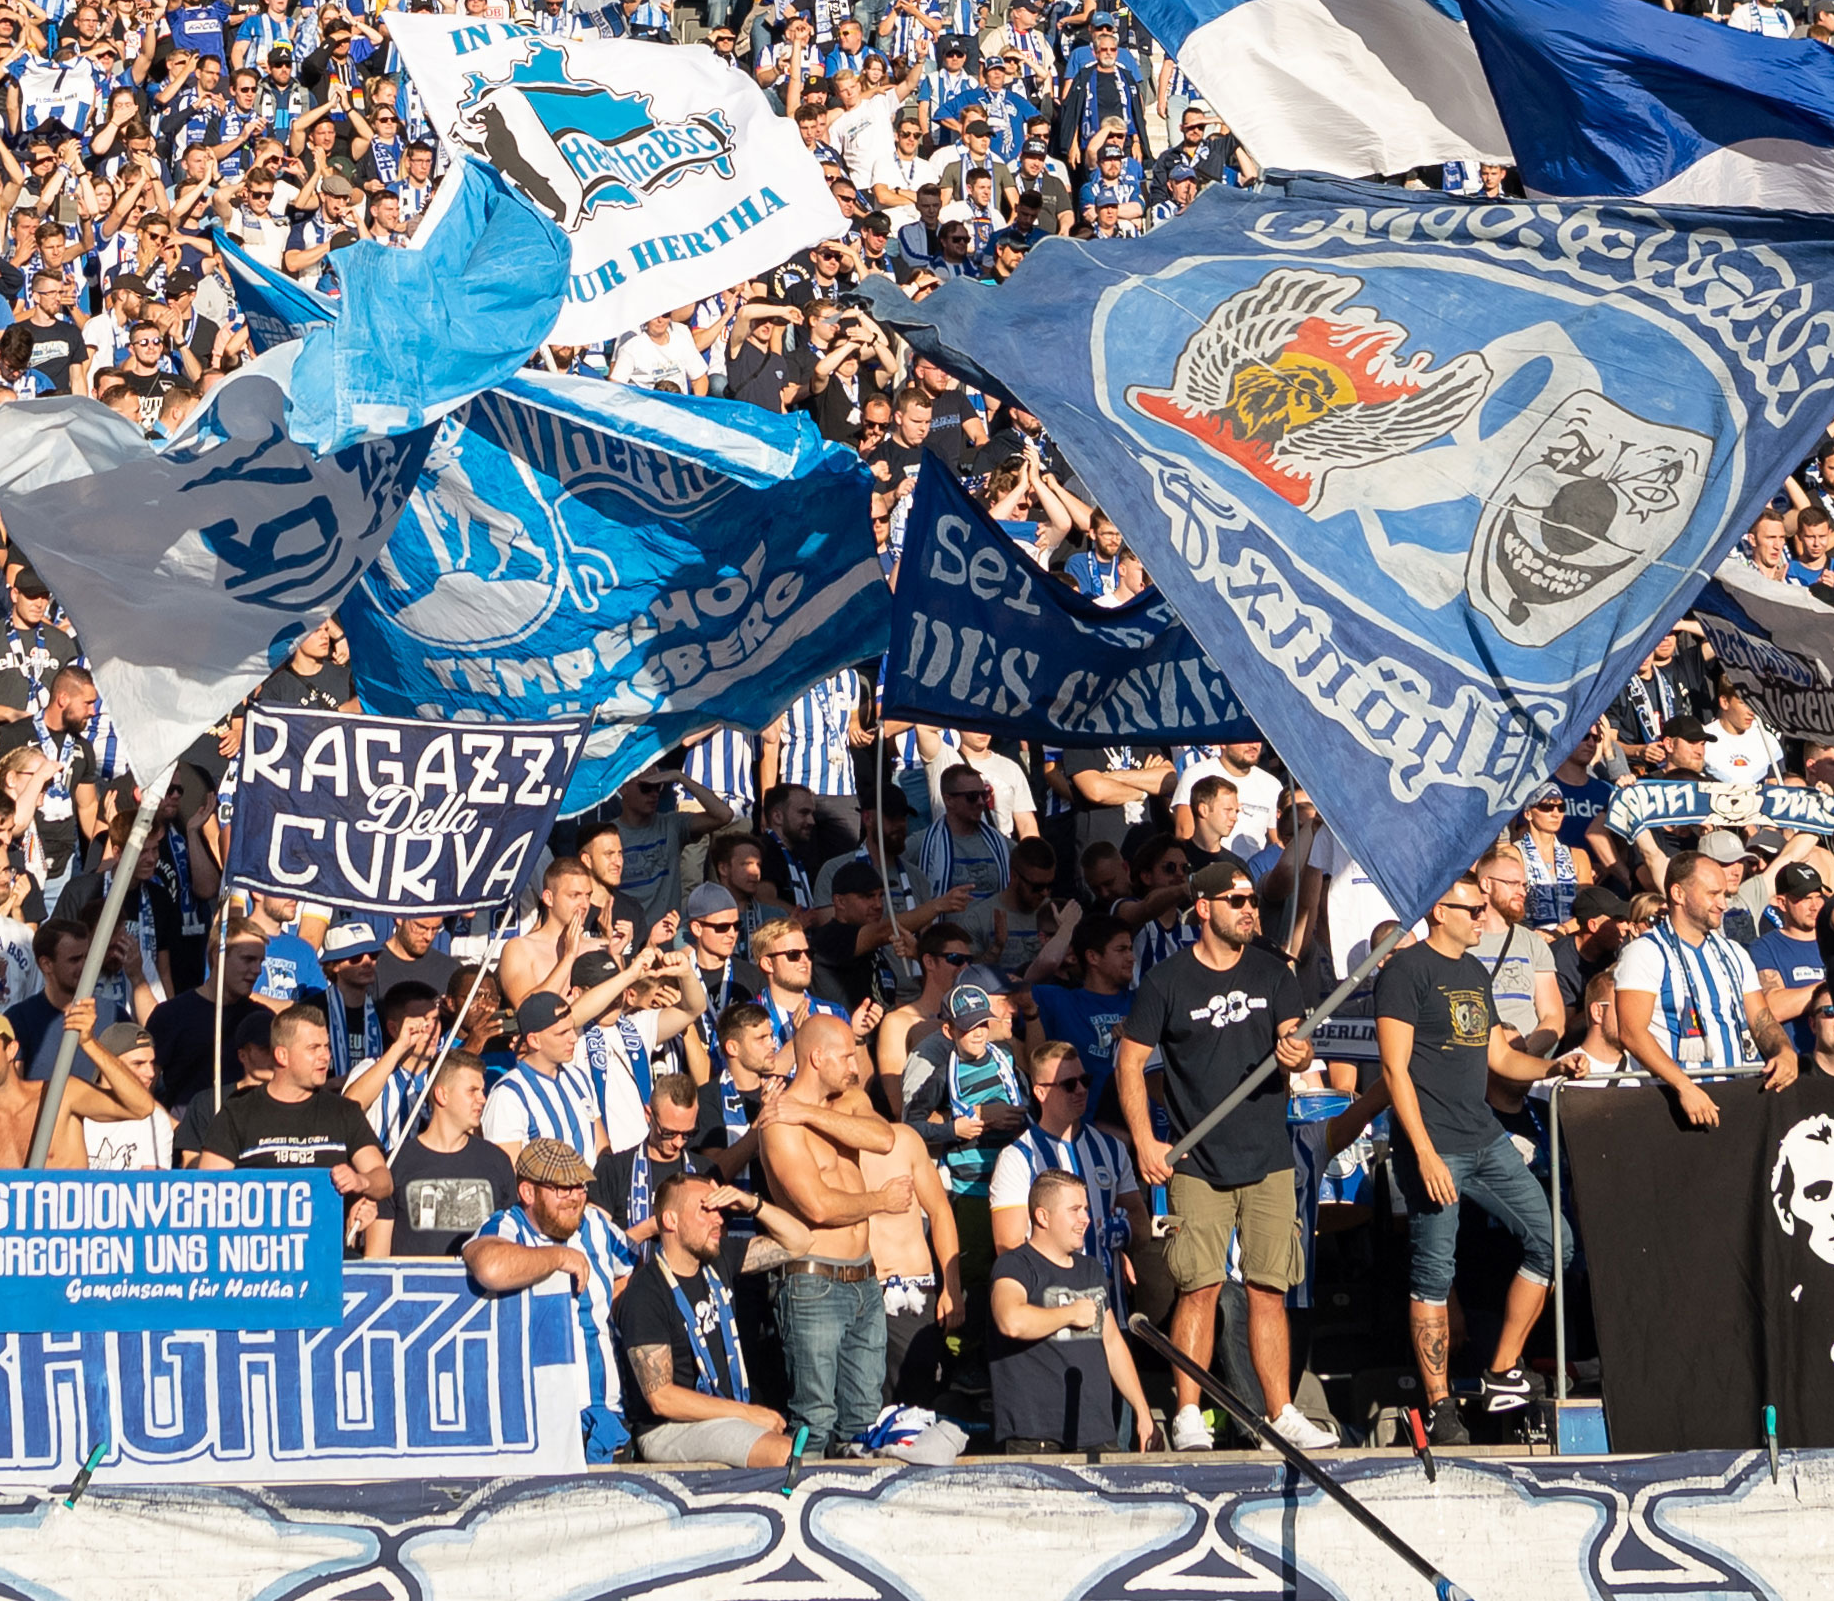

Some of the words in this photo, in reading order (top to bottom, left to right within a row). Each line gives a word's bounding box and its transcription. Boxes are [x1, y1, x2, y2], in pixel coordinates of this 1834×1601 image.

[449, 27, 490, 56] IN
[632, 186, 787, 275] HERTHA
[1050, 654, 1250, 734] GANZE
[358, 784, 478, 839] Della
[268, 810, 535, 904] CURVA
[6, 942, 30, 971] BSC
[145, 1233, 208, 1276] UNS
[219, 1232, 305, 1274] NICHT
[66, 1278, 183, 1304] Gemeinsam
[187, 1278, 221, 1303] für
[224, 1278, 295, 1302] Hertha
